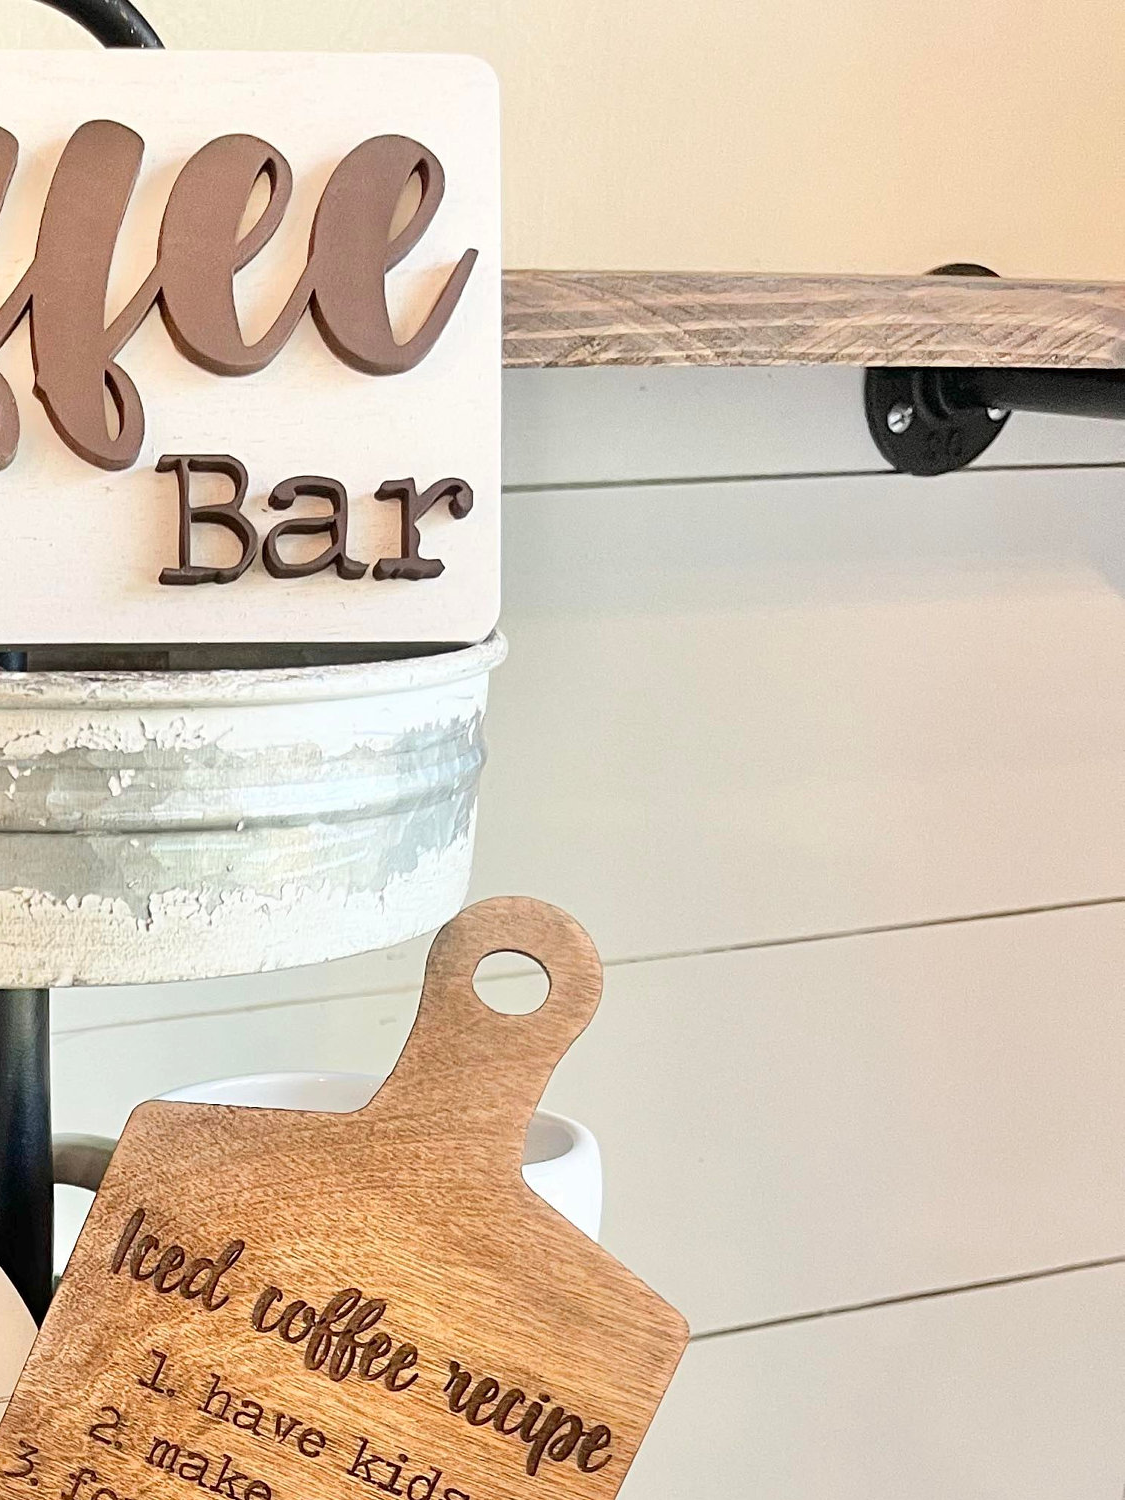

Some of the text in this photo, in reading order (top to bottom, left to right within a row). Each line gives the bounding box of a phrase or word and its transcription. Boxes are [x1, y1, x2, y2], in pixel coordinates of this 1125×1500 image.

[155, 453, 474, 587] Bar
[110, 1207, 613, 1476] Iced coffee recipe
[88, 1405, 123, 1450] 2.
[136, 1350, 175, 1400] 1.
[199, 1375, 328, 1458] have
[3, 1440, 40, 1488] 3.
